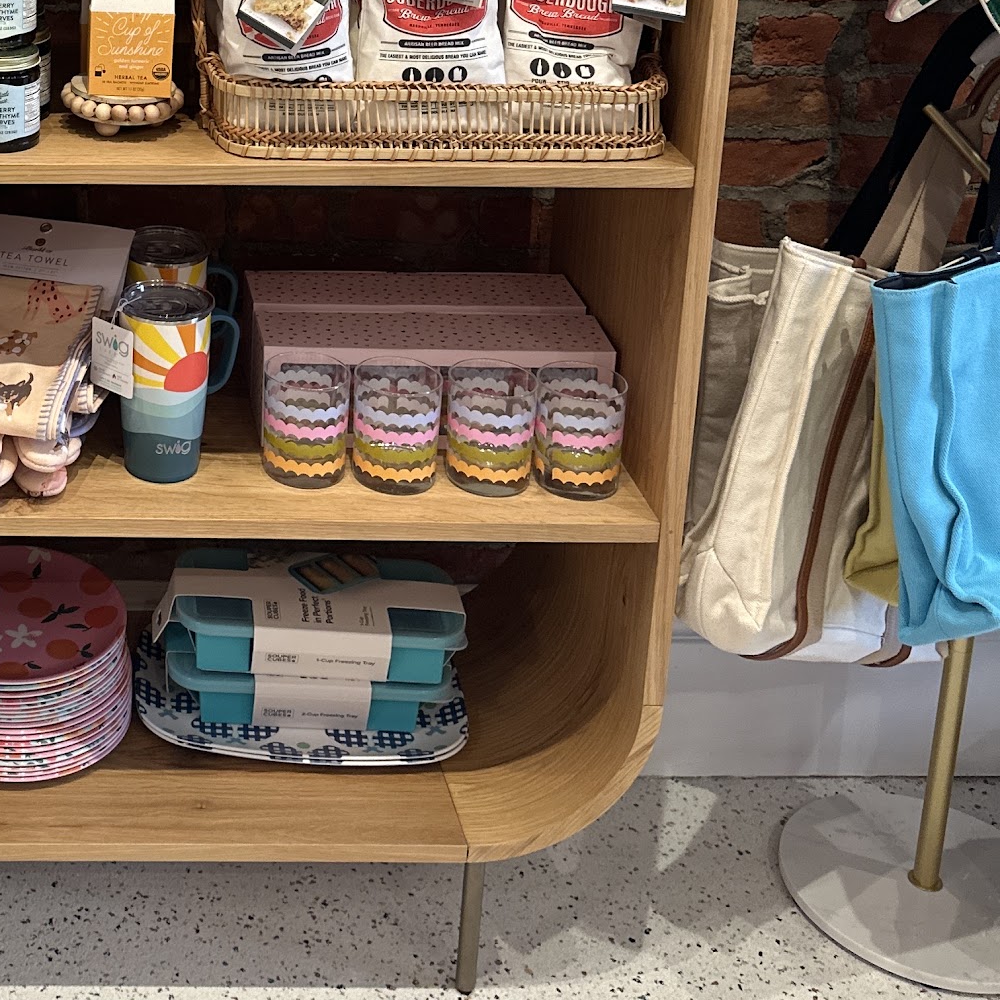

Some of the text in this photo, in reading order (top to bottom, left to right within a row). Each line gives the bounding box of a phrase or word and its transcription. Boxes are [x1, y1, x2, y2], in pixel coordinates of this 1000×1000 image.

[528, 4, 599, 21] Brew Bread
[112, 16, 161, 45] Cup of
[97, 35, 164, 57] Sunshine
[0, 250, 69, 266] TEA TOWEL
[95, 331, 129, 357] swig
[155, 440, 192, 455] swig
